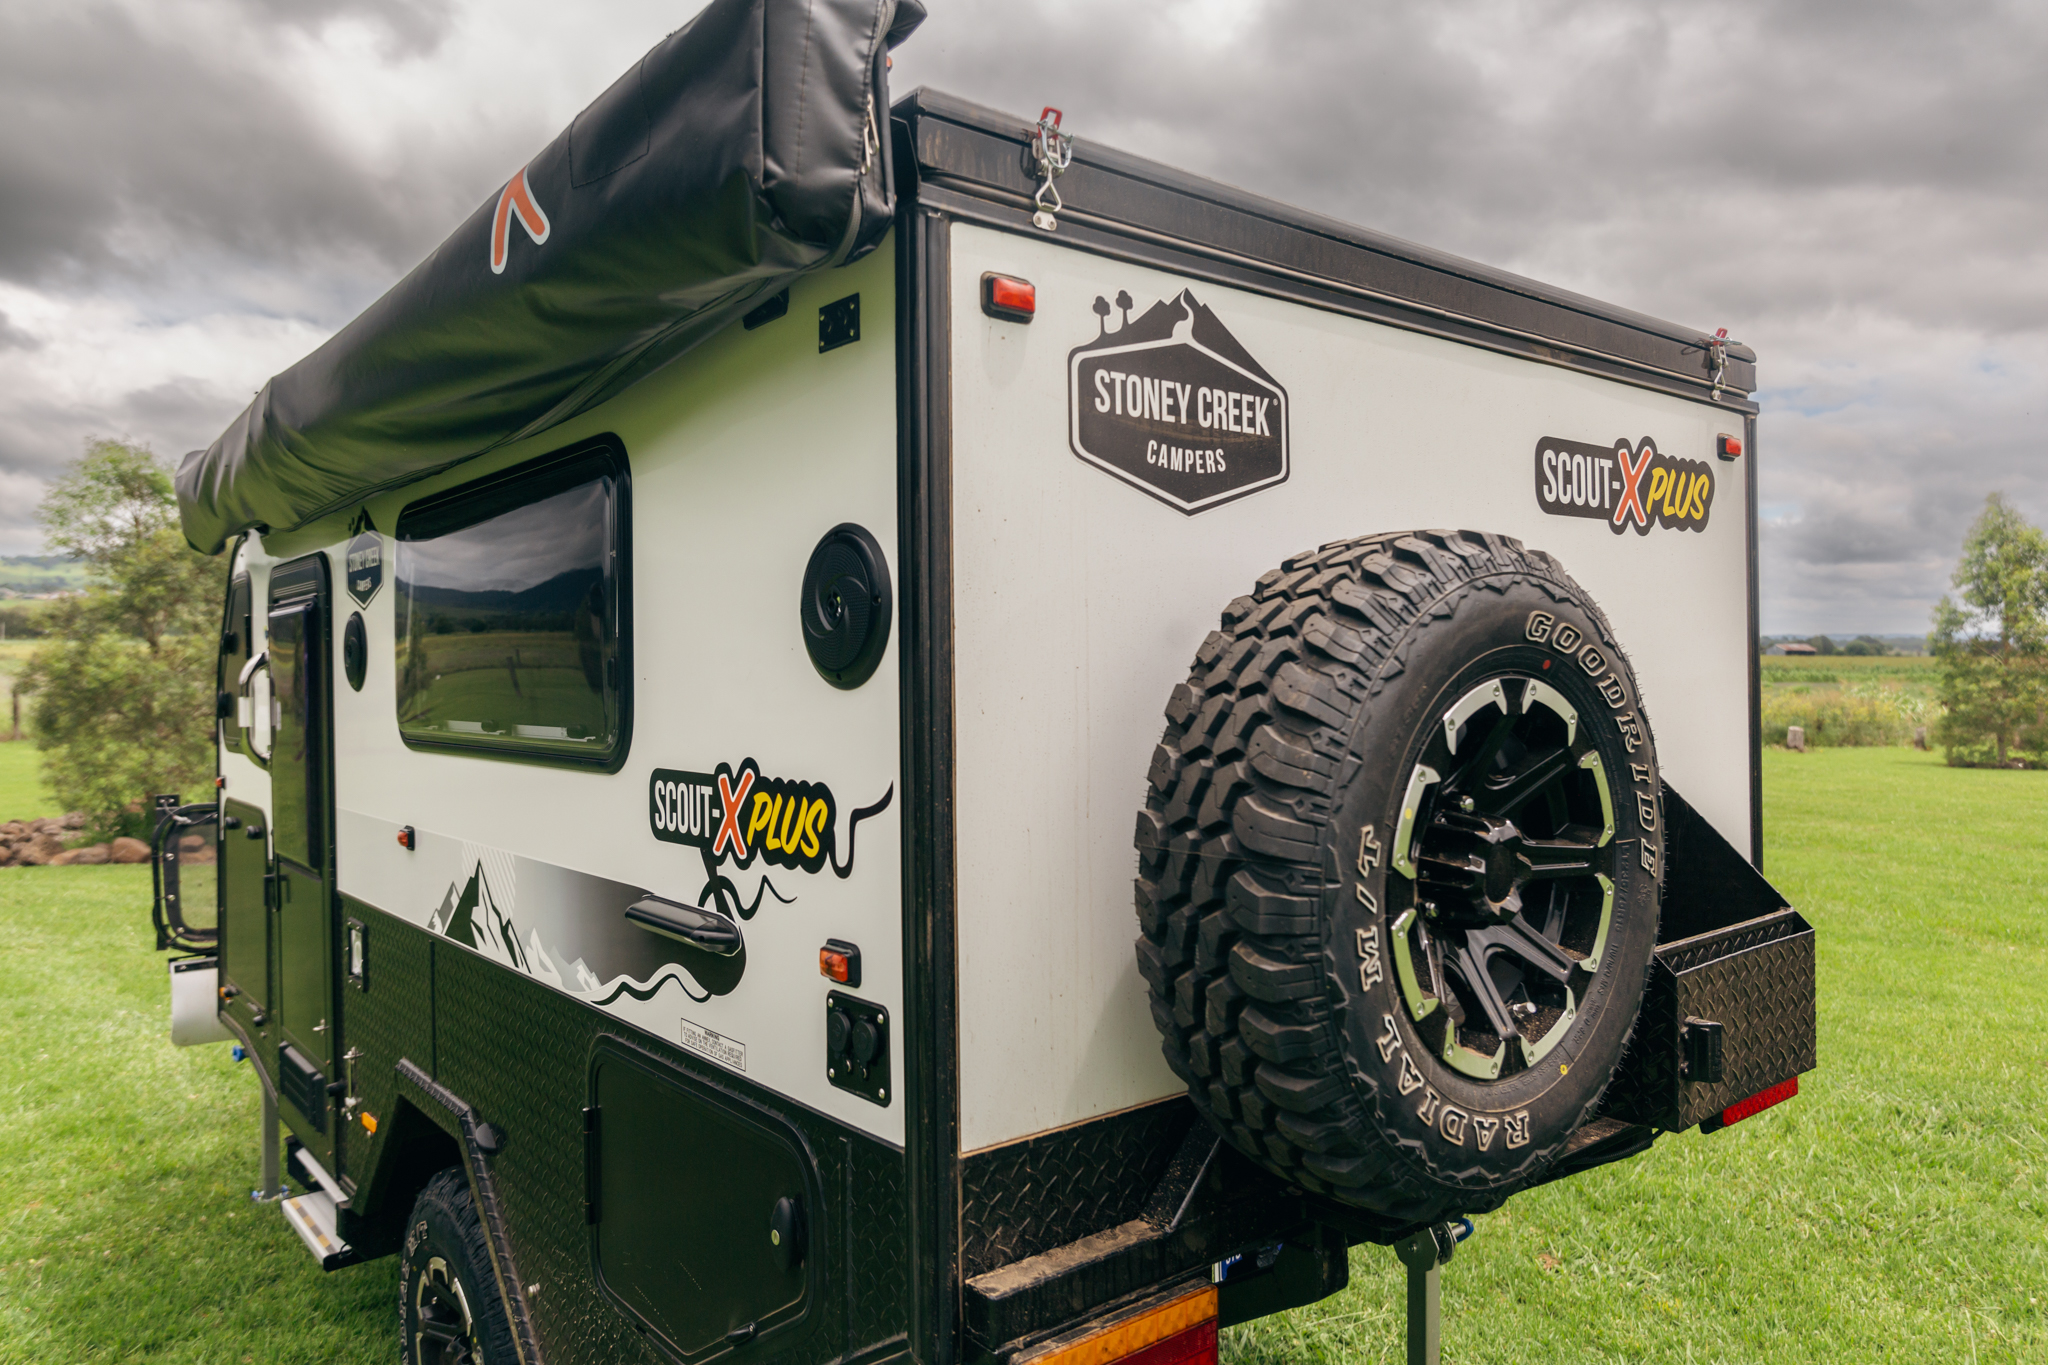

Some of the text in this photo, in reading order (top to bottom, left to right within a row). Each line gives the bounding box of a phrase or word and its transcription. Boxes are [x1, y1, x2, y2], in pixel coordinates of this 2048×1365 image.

[1094, 368, 1271, 437] STONEY CREEK
[1146, 439, 1227, 474] CAMPERS
[1646, 466, 1710, 520] PLUS
[1525, 610, 1658, 878] GOODRIDE
[746, 791, 829, 858] PLUS
[1354, 823, 1530, 1152] RADIAL M/T
